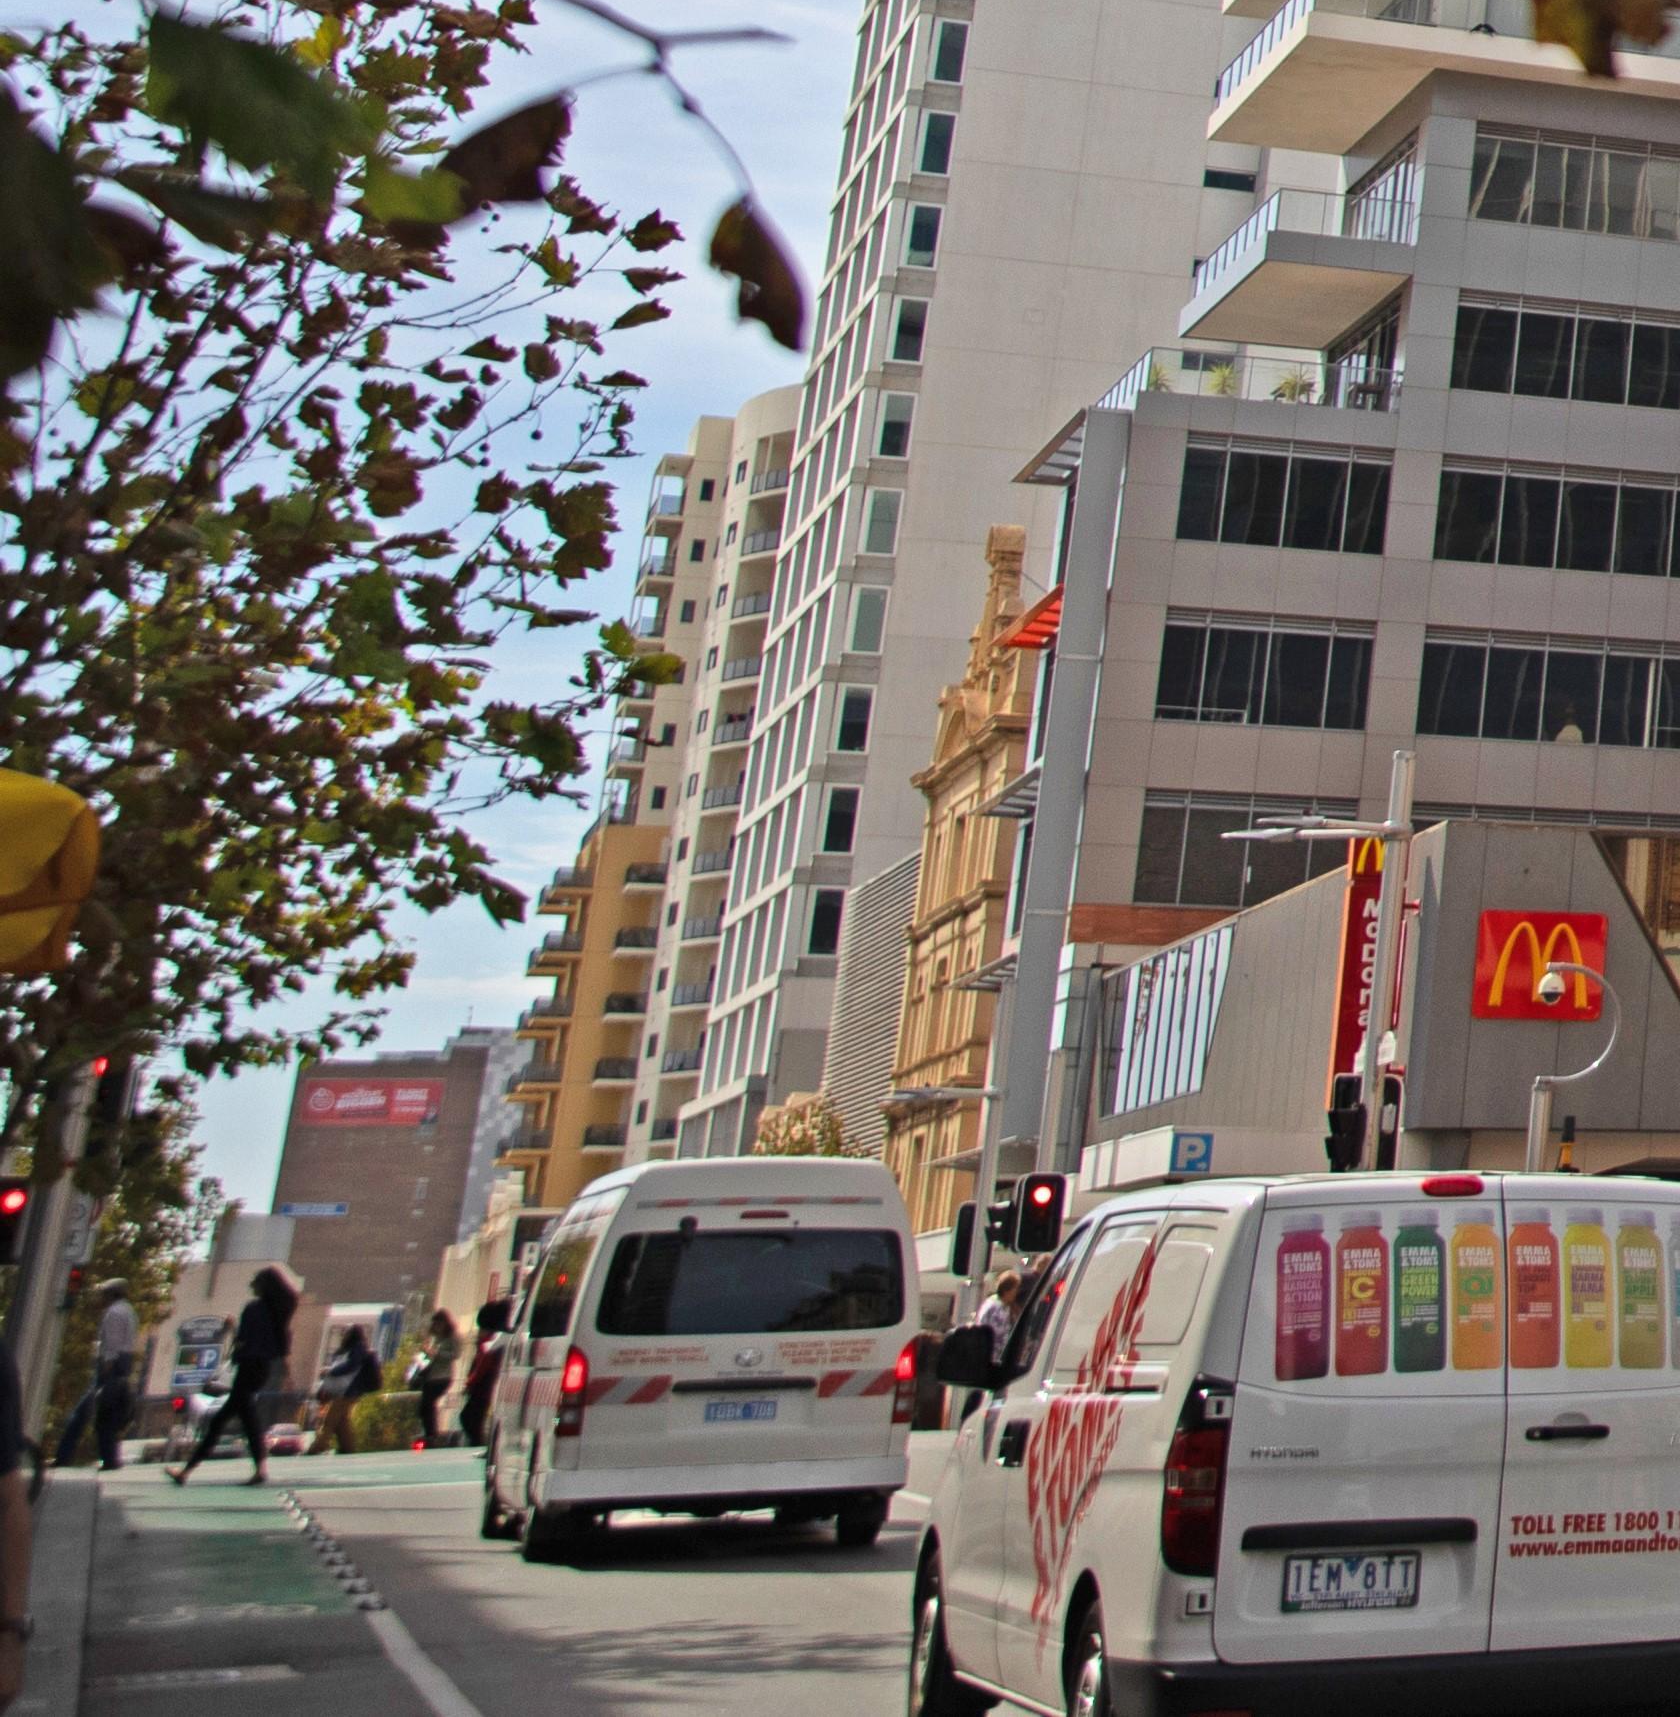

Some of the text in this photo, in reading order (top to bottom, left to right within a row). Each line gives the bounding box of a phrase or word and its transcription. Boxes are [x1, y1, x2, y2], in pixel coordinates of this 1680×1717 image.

[1177, 1136, 1208, 1167] P
[1343, 1248, 1381, 1260] EMMA
[1401, 1246, 1438, 1257] EMMA
[1458, 1246, 1494, 1257] EMMA
[1516, 1245, 1551, 1256] EMMA
[1570, 1245, 1604, 1255] EMMA
[1283, 1251, 1322, 1264] EMMA
[1401, 1273, 1439, 1286] GREEN
[1402, 1285, 1439, 1297] POWER
[1250, 1445, 1320, 1460] HYUNDAI
[1510, 1514, 1556, 1536] TOLL
[1562, 1512, 1608, 1535] FREE
[1613, 1509, 1660, 1532] 1800
[1292, 1558, 1414, 1593] 1EM 8TT
